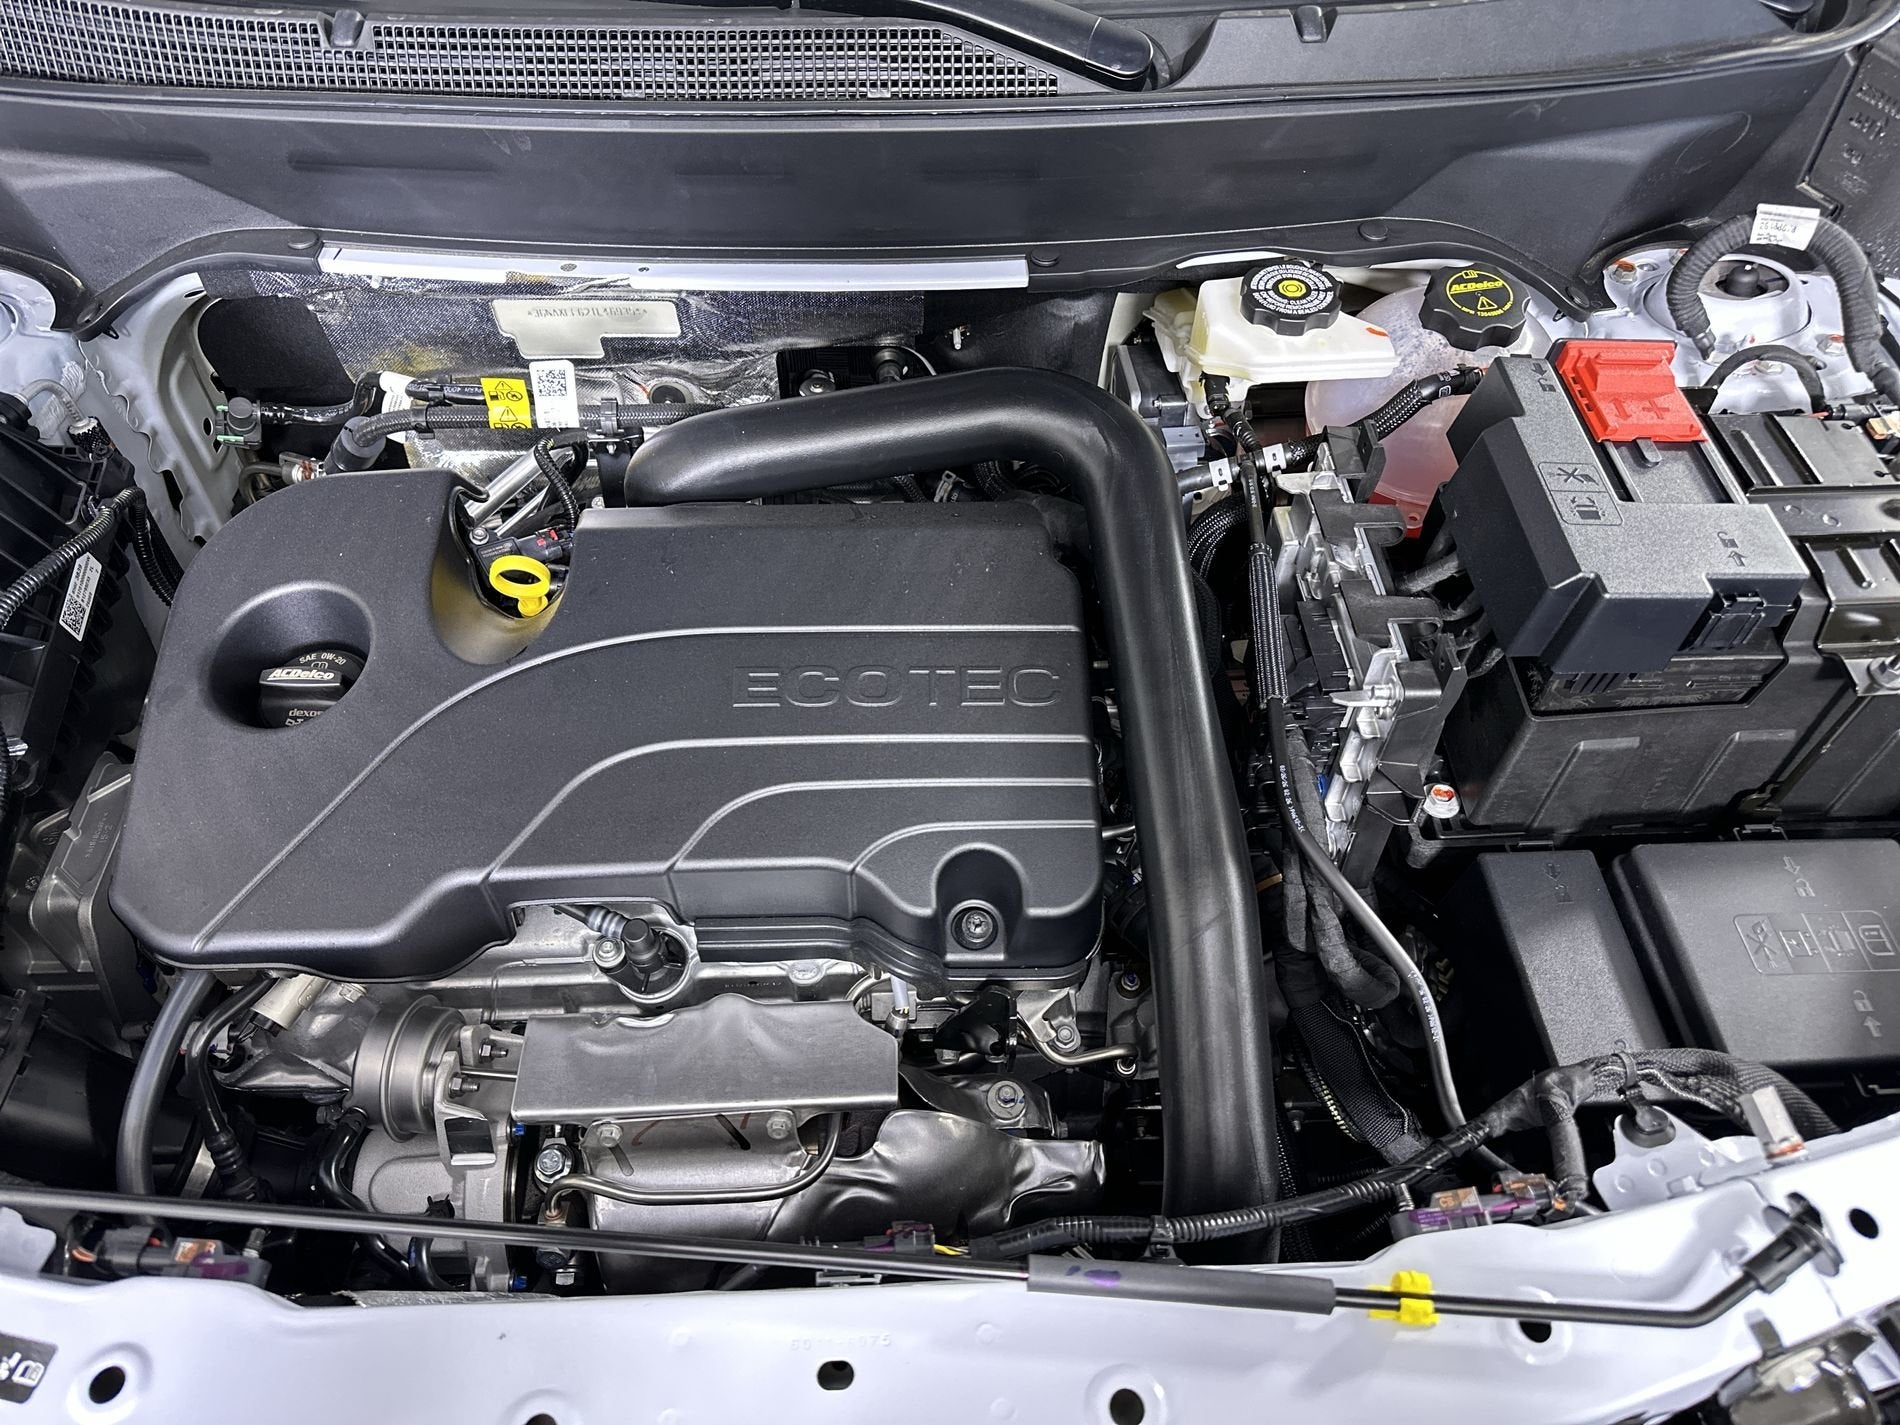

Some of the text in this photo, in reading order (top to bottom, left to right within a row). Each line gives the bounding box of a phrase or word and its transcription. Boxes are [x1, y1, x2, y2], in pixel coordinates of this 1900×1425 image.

[1450, 281, 1503, 294] ACDelco
[299, 652, 347, 665] SAE 0W-20
[267, 668, 335, 681] ACDelco
[732, 665, 1063, 707] ECOTEC
